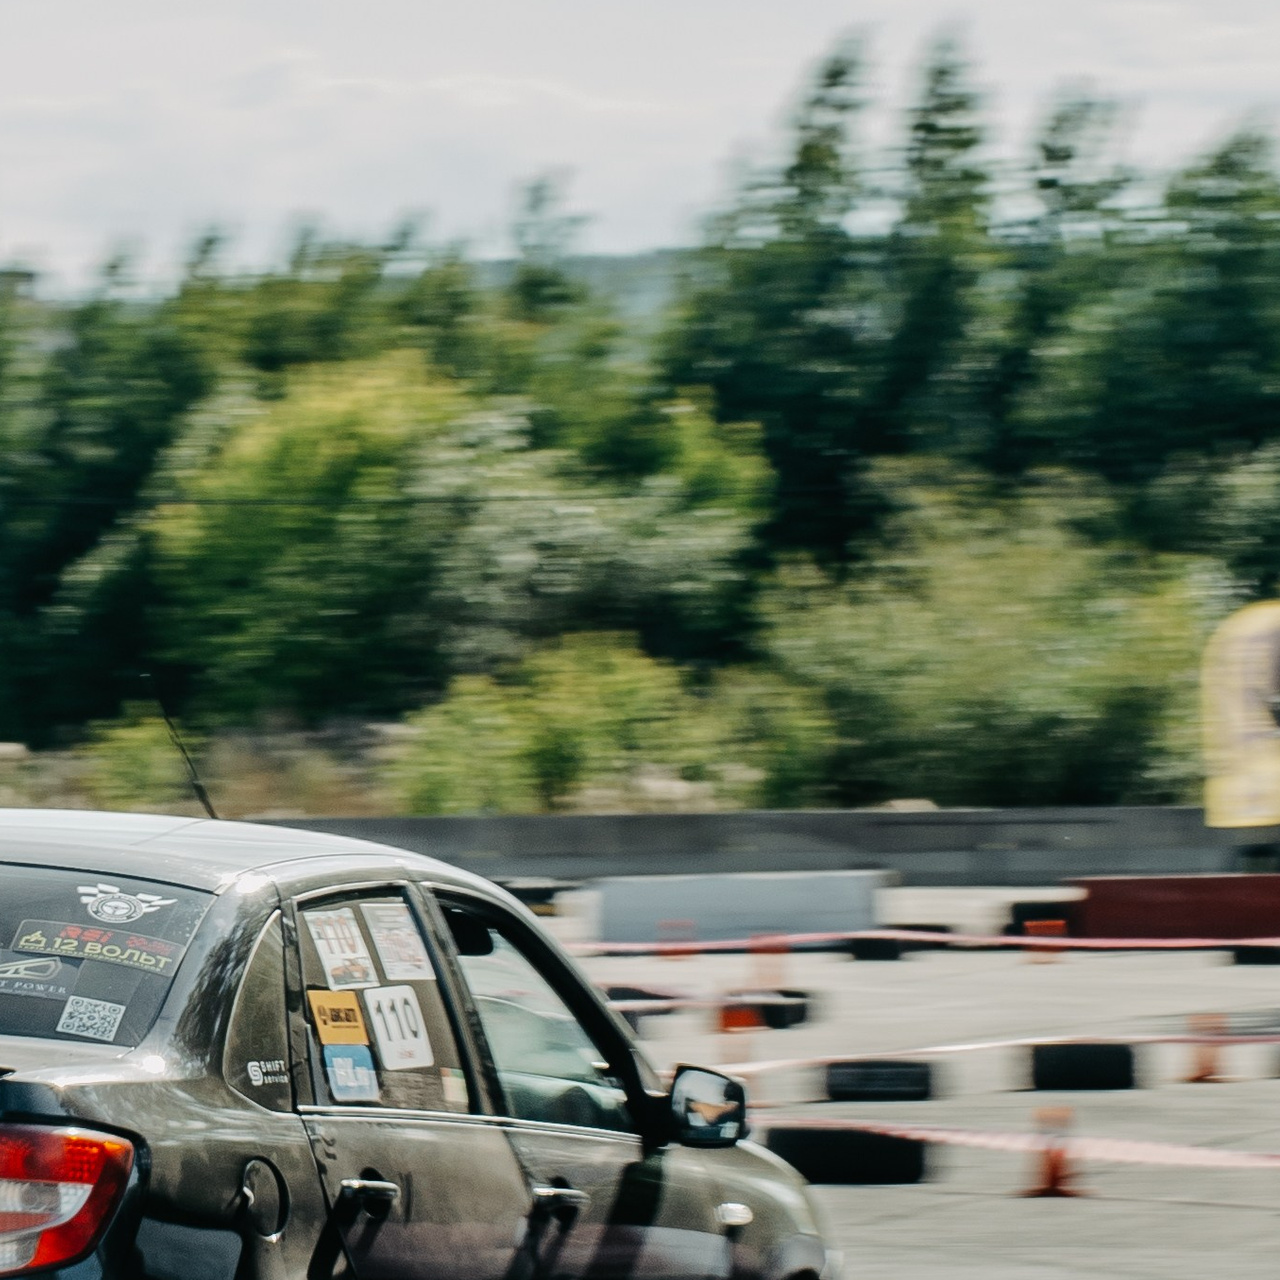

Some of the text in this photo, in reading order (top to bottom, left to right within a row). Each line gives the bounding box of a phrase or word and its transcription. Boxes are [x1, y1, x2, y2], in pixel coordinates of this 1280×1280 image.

[53, 936, 79, 951] 12
[83, 941, 173, 969] ВОЛЬТ
[13, 981, 66, 994] POWER
[375, 997, 419, 1042] 110
